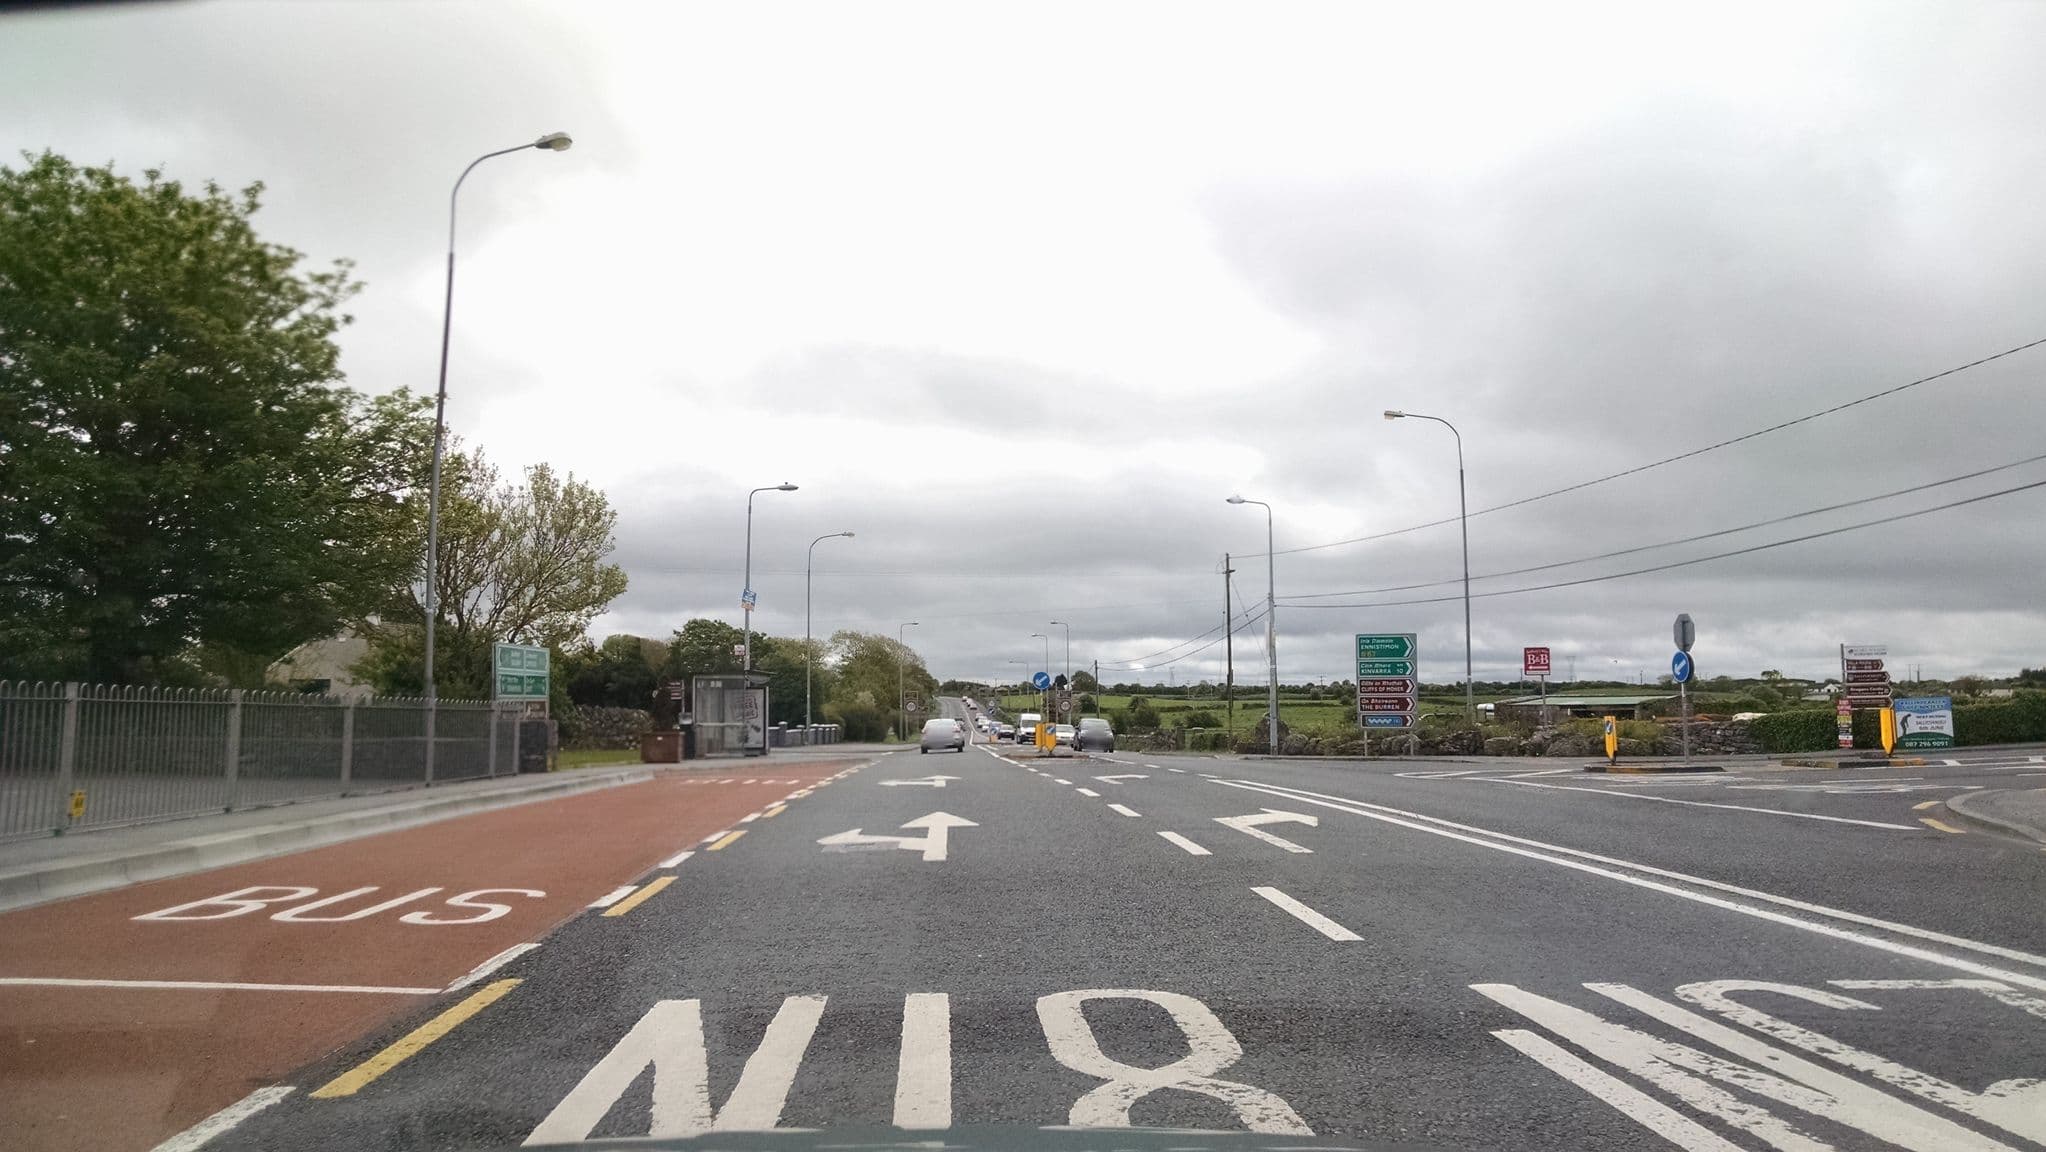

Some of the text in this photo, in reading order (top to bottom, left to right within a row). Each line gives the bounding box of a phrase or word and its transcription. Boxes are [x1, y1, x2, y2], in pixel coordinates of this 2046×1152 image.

[1528, 654, 1549, 665] B&B
[130, 886, 547, 924] BUS
[520, 989, 1318, 1146] N18
